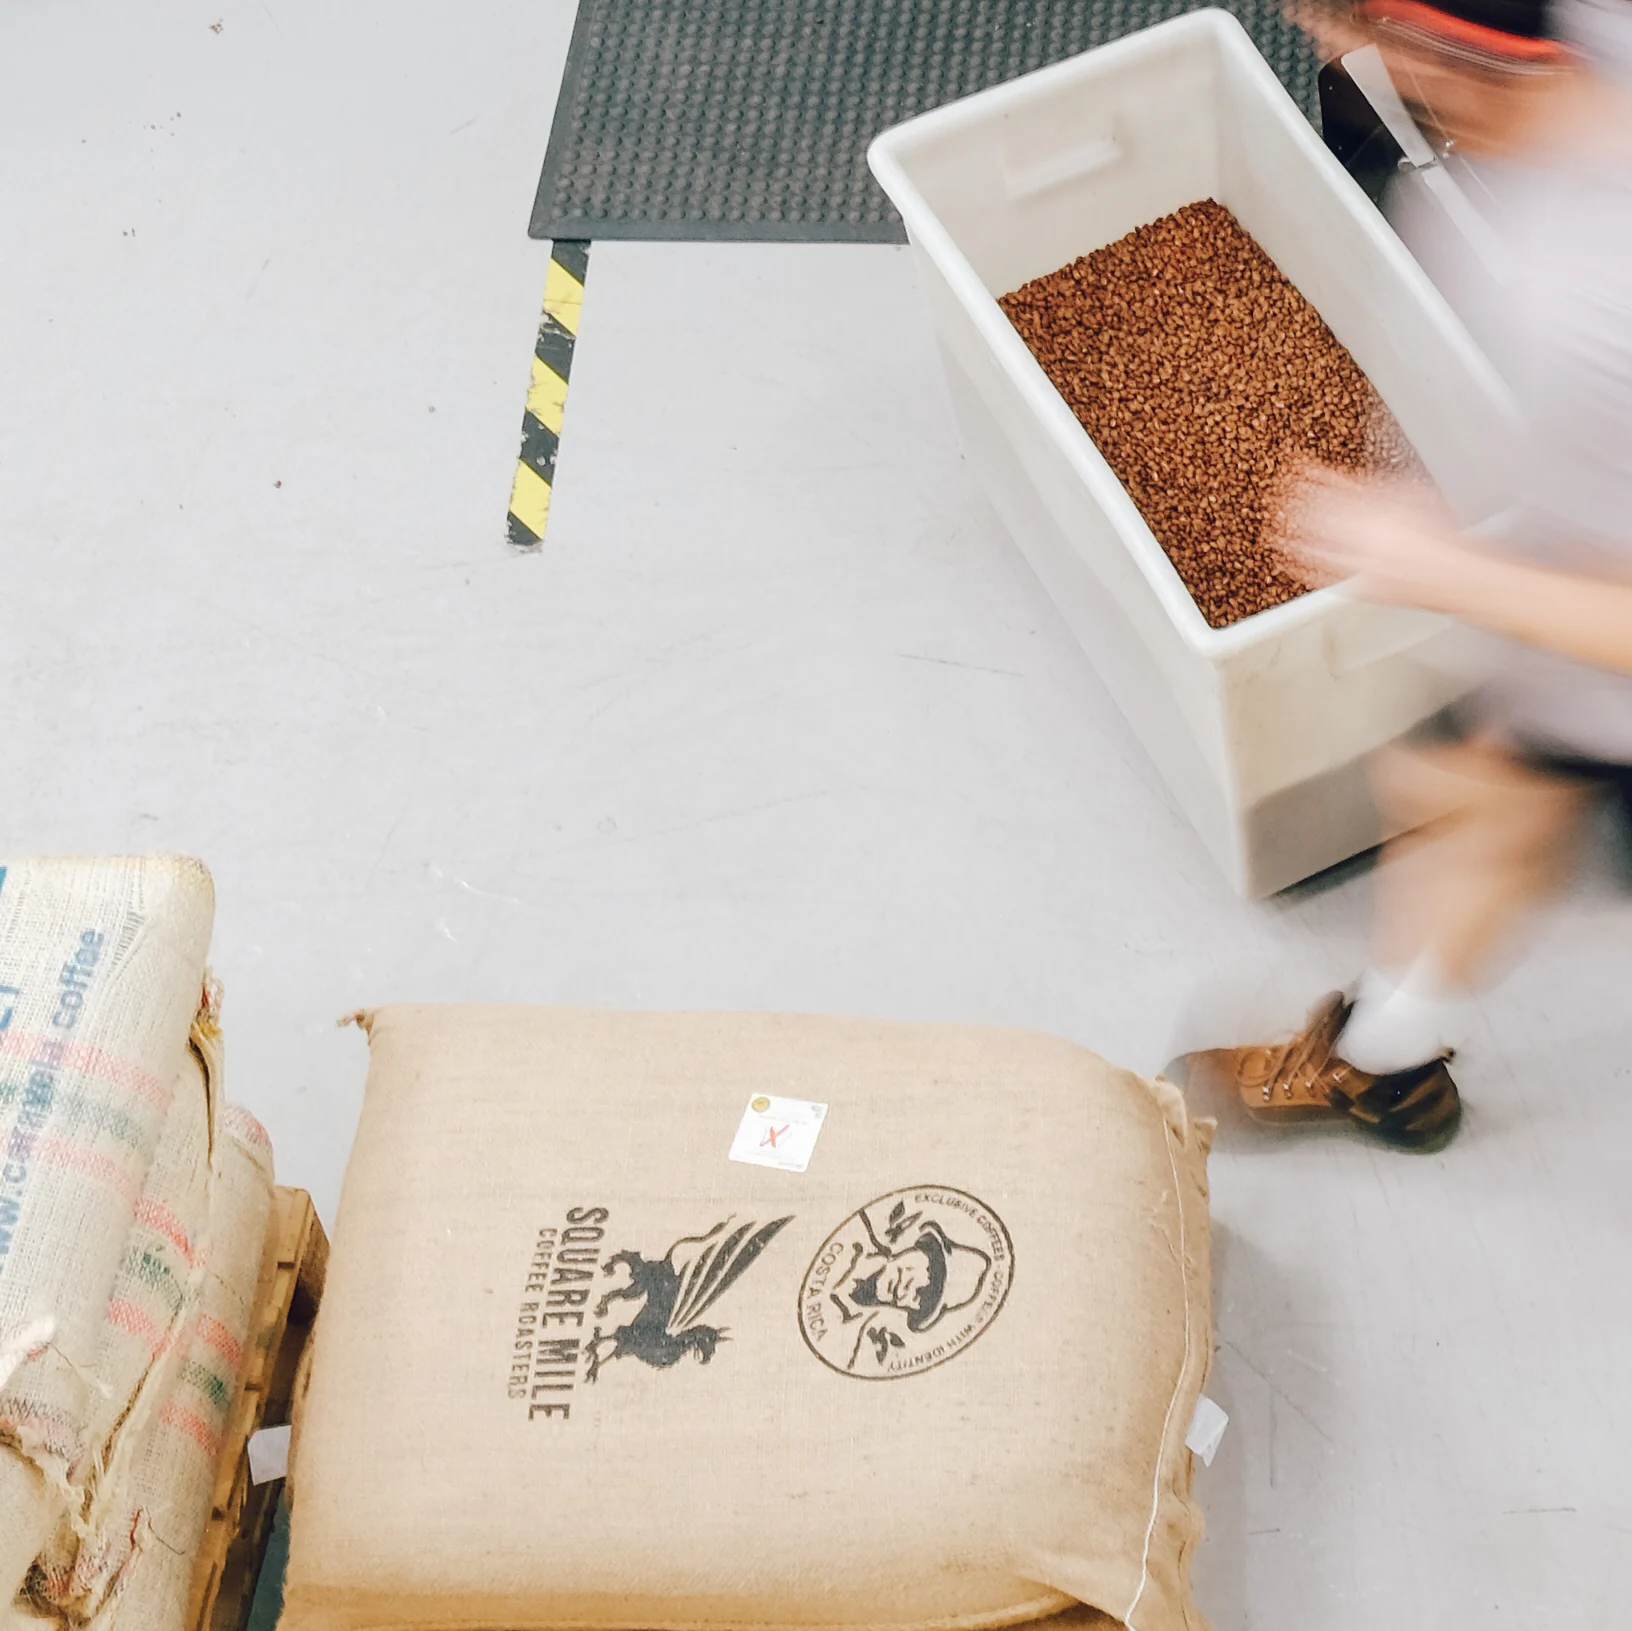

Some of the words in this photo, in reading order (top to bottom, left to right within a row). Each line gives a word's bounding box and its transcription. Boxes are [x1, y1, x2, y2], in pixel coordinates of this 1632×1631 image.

[914, 1193, 979, 1220] EXCLUSIVE
[524, 1227, 558, 1294] COFFEE
[976, 1216, 1006, 1262] COFFEES
[541, 1206, 610, 1329] SQUARE
[807, 1241, 845, 1300] COSTA
[806, 1302, 829, 1343] RICA
[945, 1323, 976, 1350] WITH
[507, 1301, 540, 1400] ROASTERS
[887, 1345, 945, 1373] IDENTITY
[527, 1338, 581, 1422] MILE
